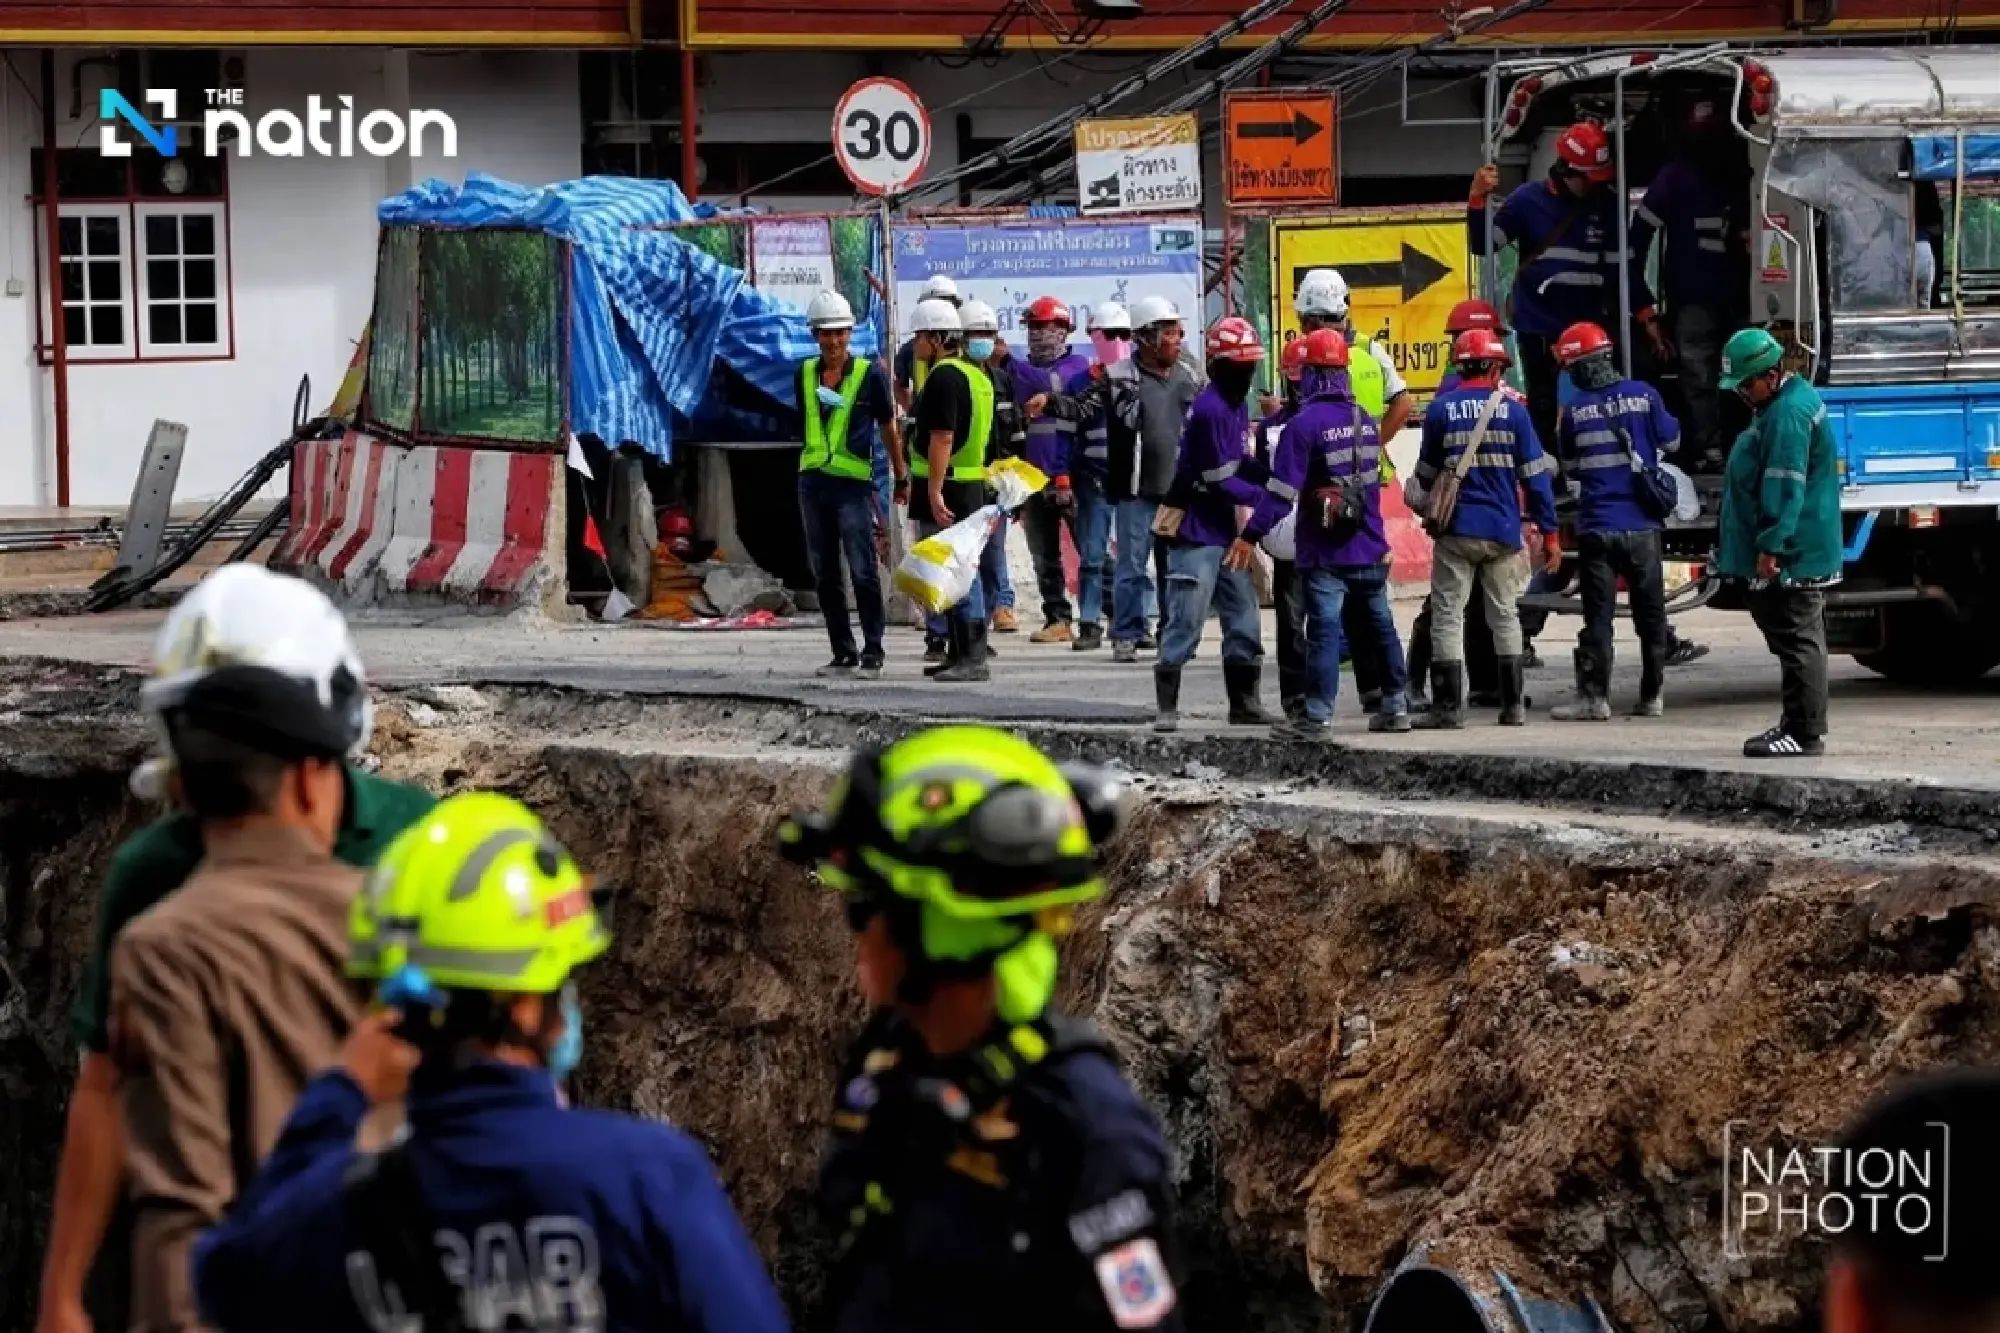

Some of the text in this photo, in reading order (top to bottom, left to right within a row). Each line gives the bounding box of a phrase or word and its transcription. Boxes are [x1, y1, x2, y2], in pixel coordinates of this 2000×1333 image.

[845, 109, 920, 161] 30
[1123, 154, 1177, 177] ผิวทาง
